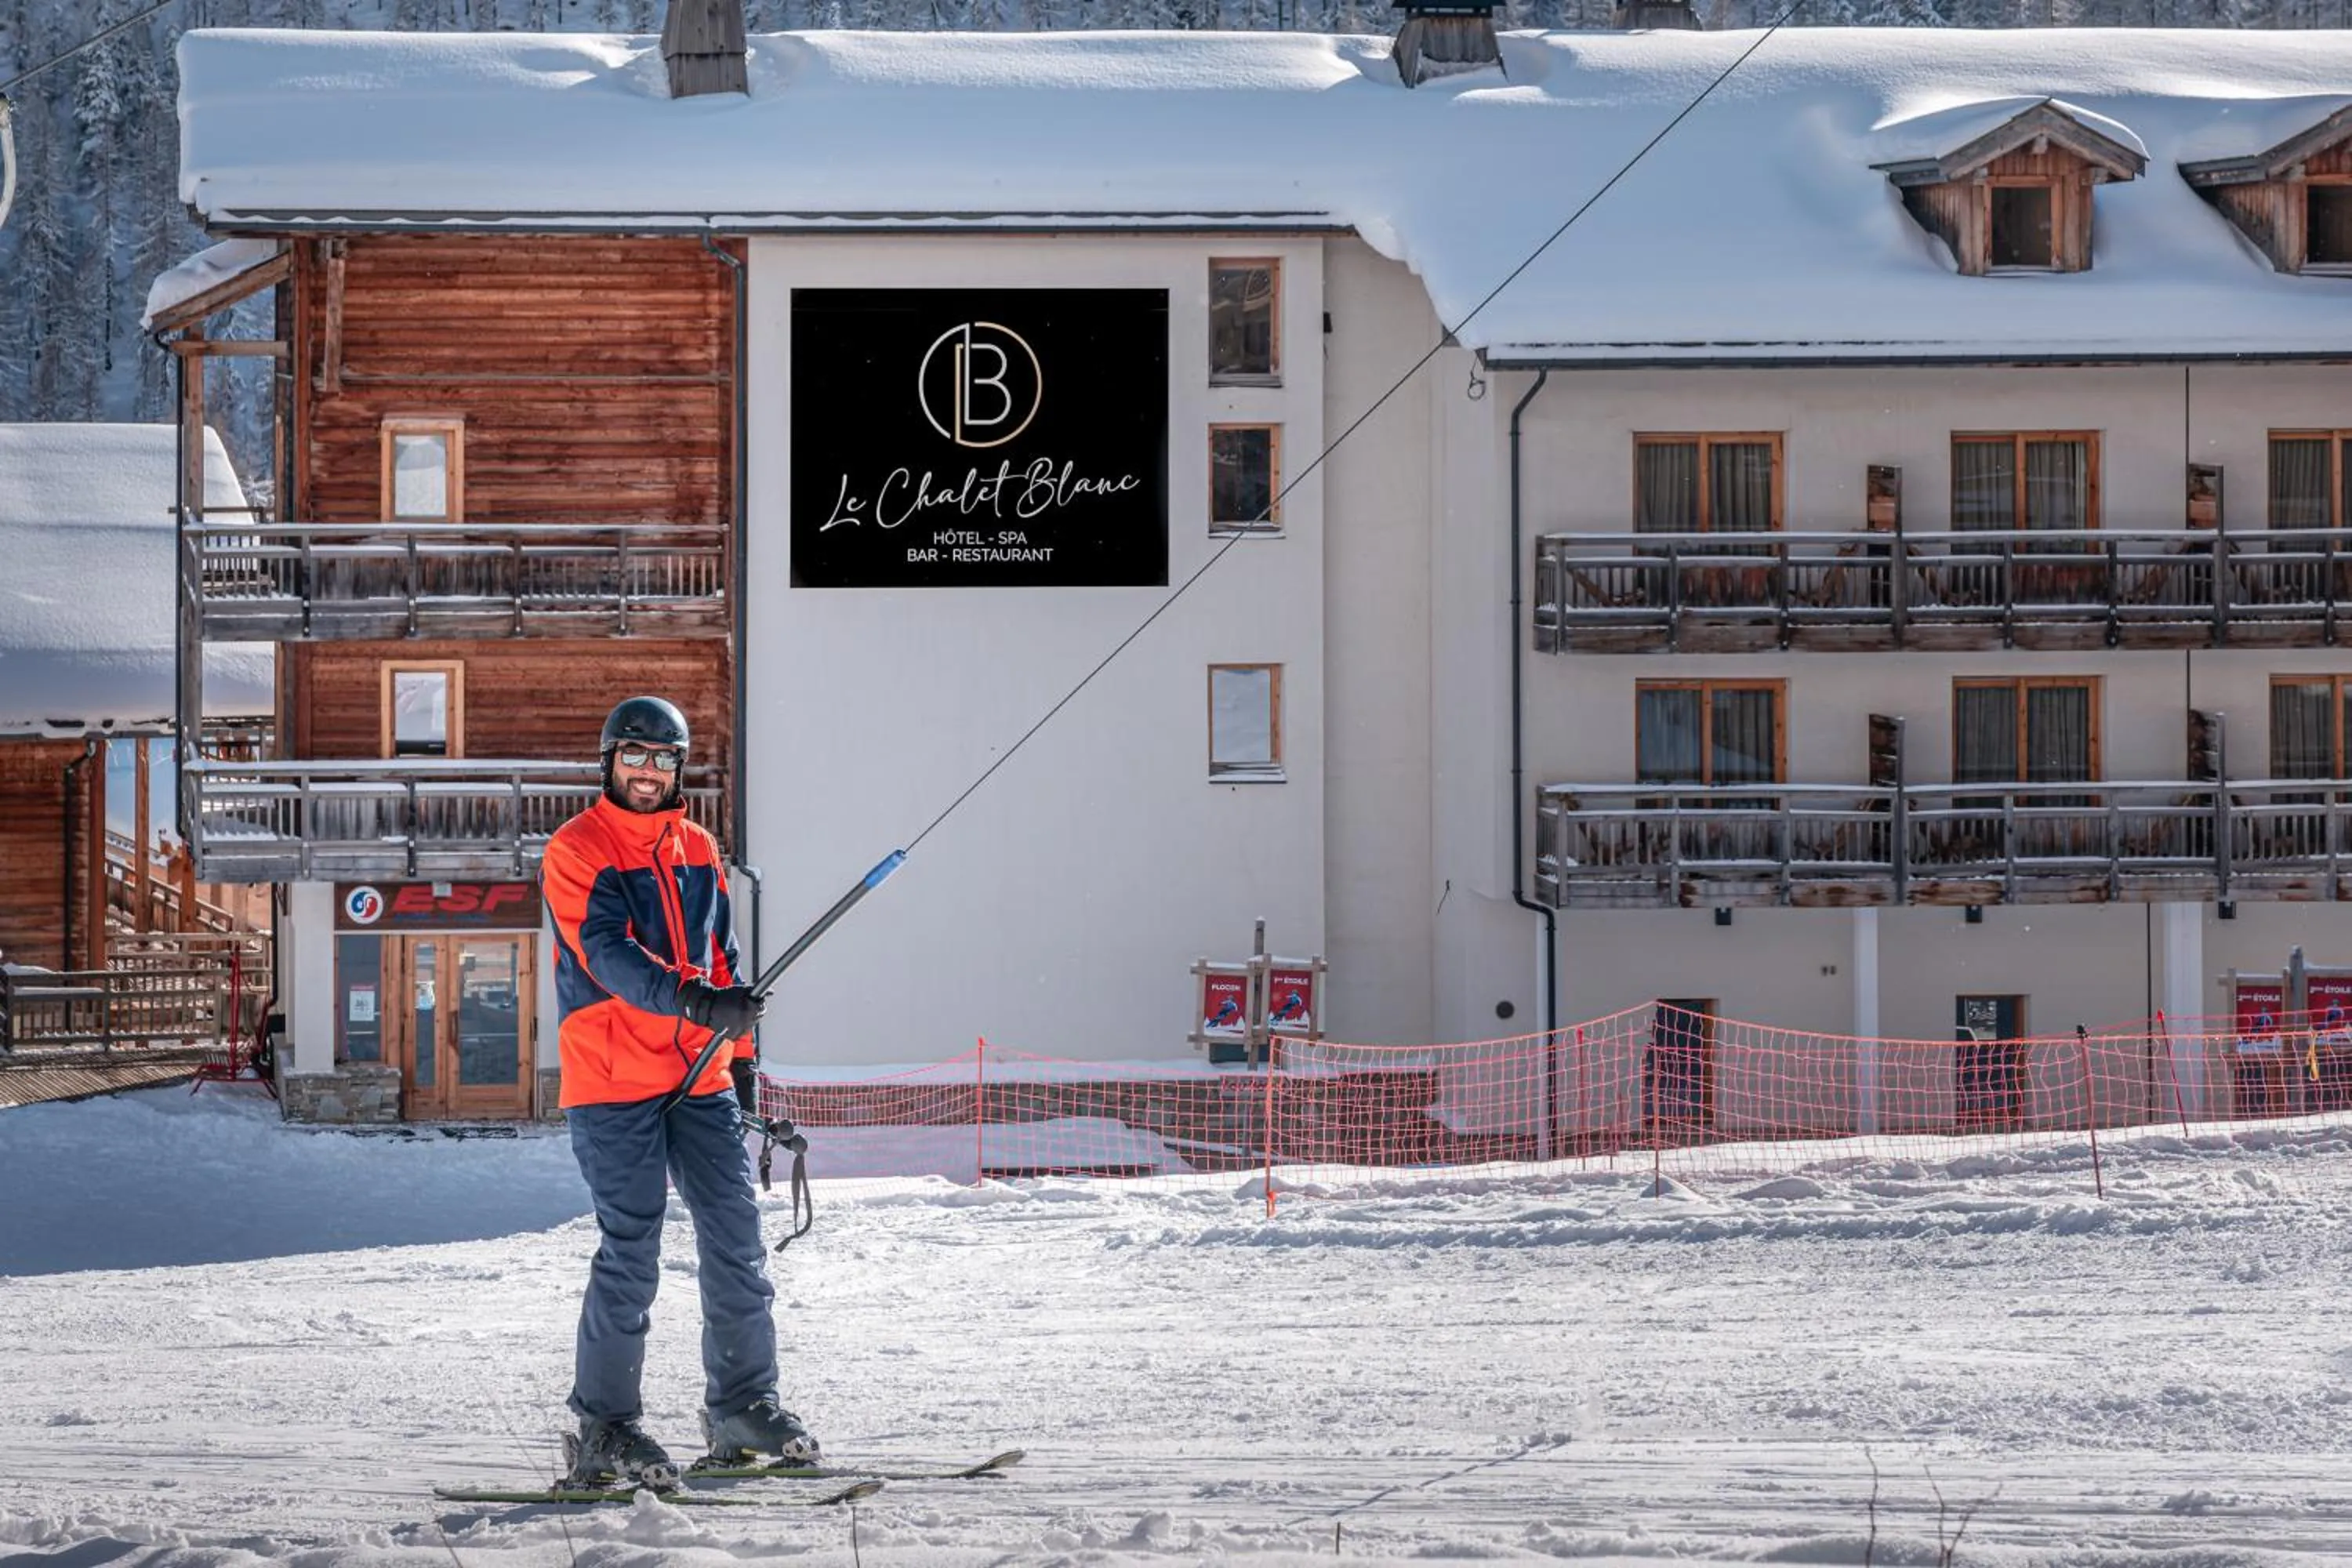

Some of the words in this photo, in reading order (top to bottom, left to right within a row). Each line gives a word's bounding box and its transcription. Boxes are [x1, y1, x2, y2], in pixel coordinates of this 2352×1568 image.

[819, 474, 867, 532] Le
[876, 459, 1027, 528] Chalet
[1016, 457, 1141, 519] Blanc
[934, 528, 985, 545] HÔTEL
[998, 531, 1028, 545] SPA
[907, 548, 938, 562] BAR
[953, 548, 1054, 562] RESTAURANT
[393, 884, 528, 912] ESF
